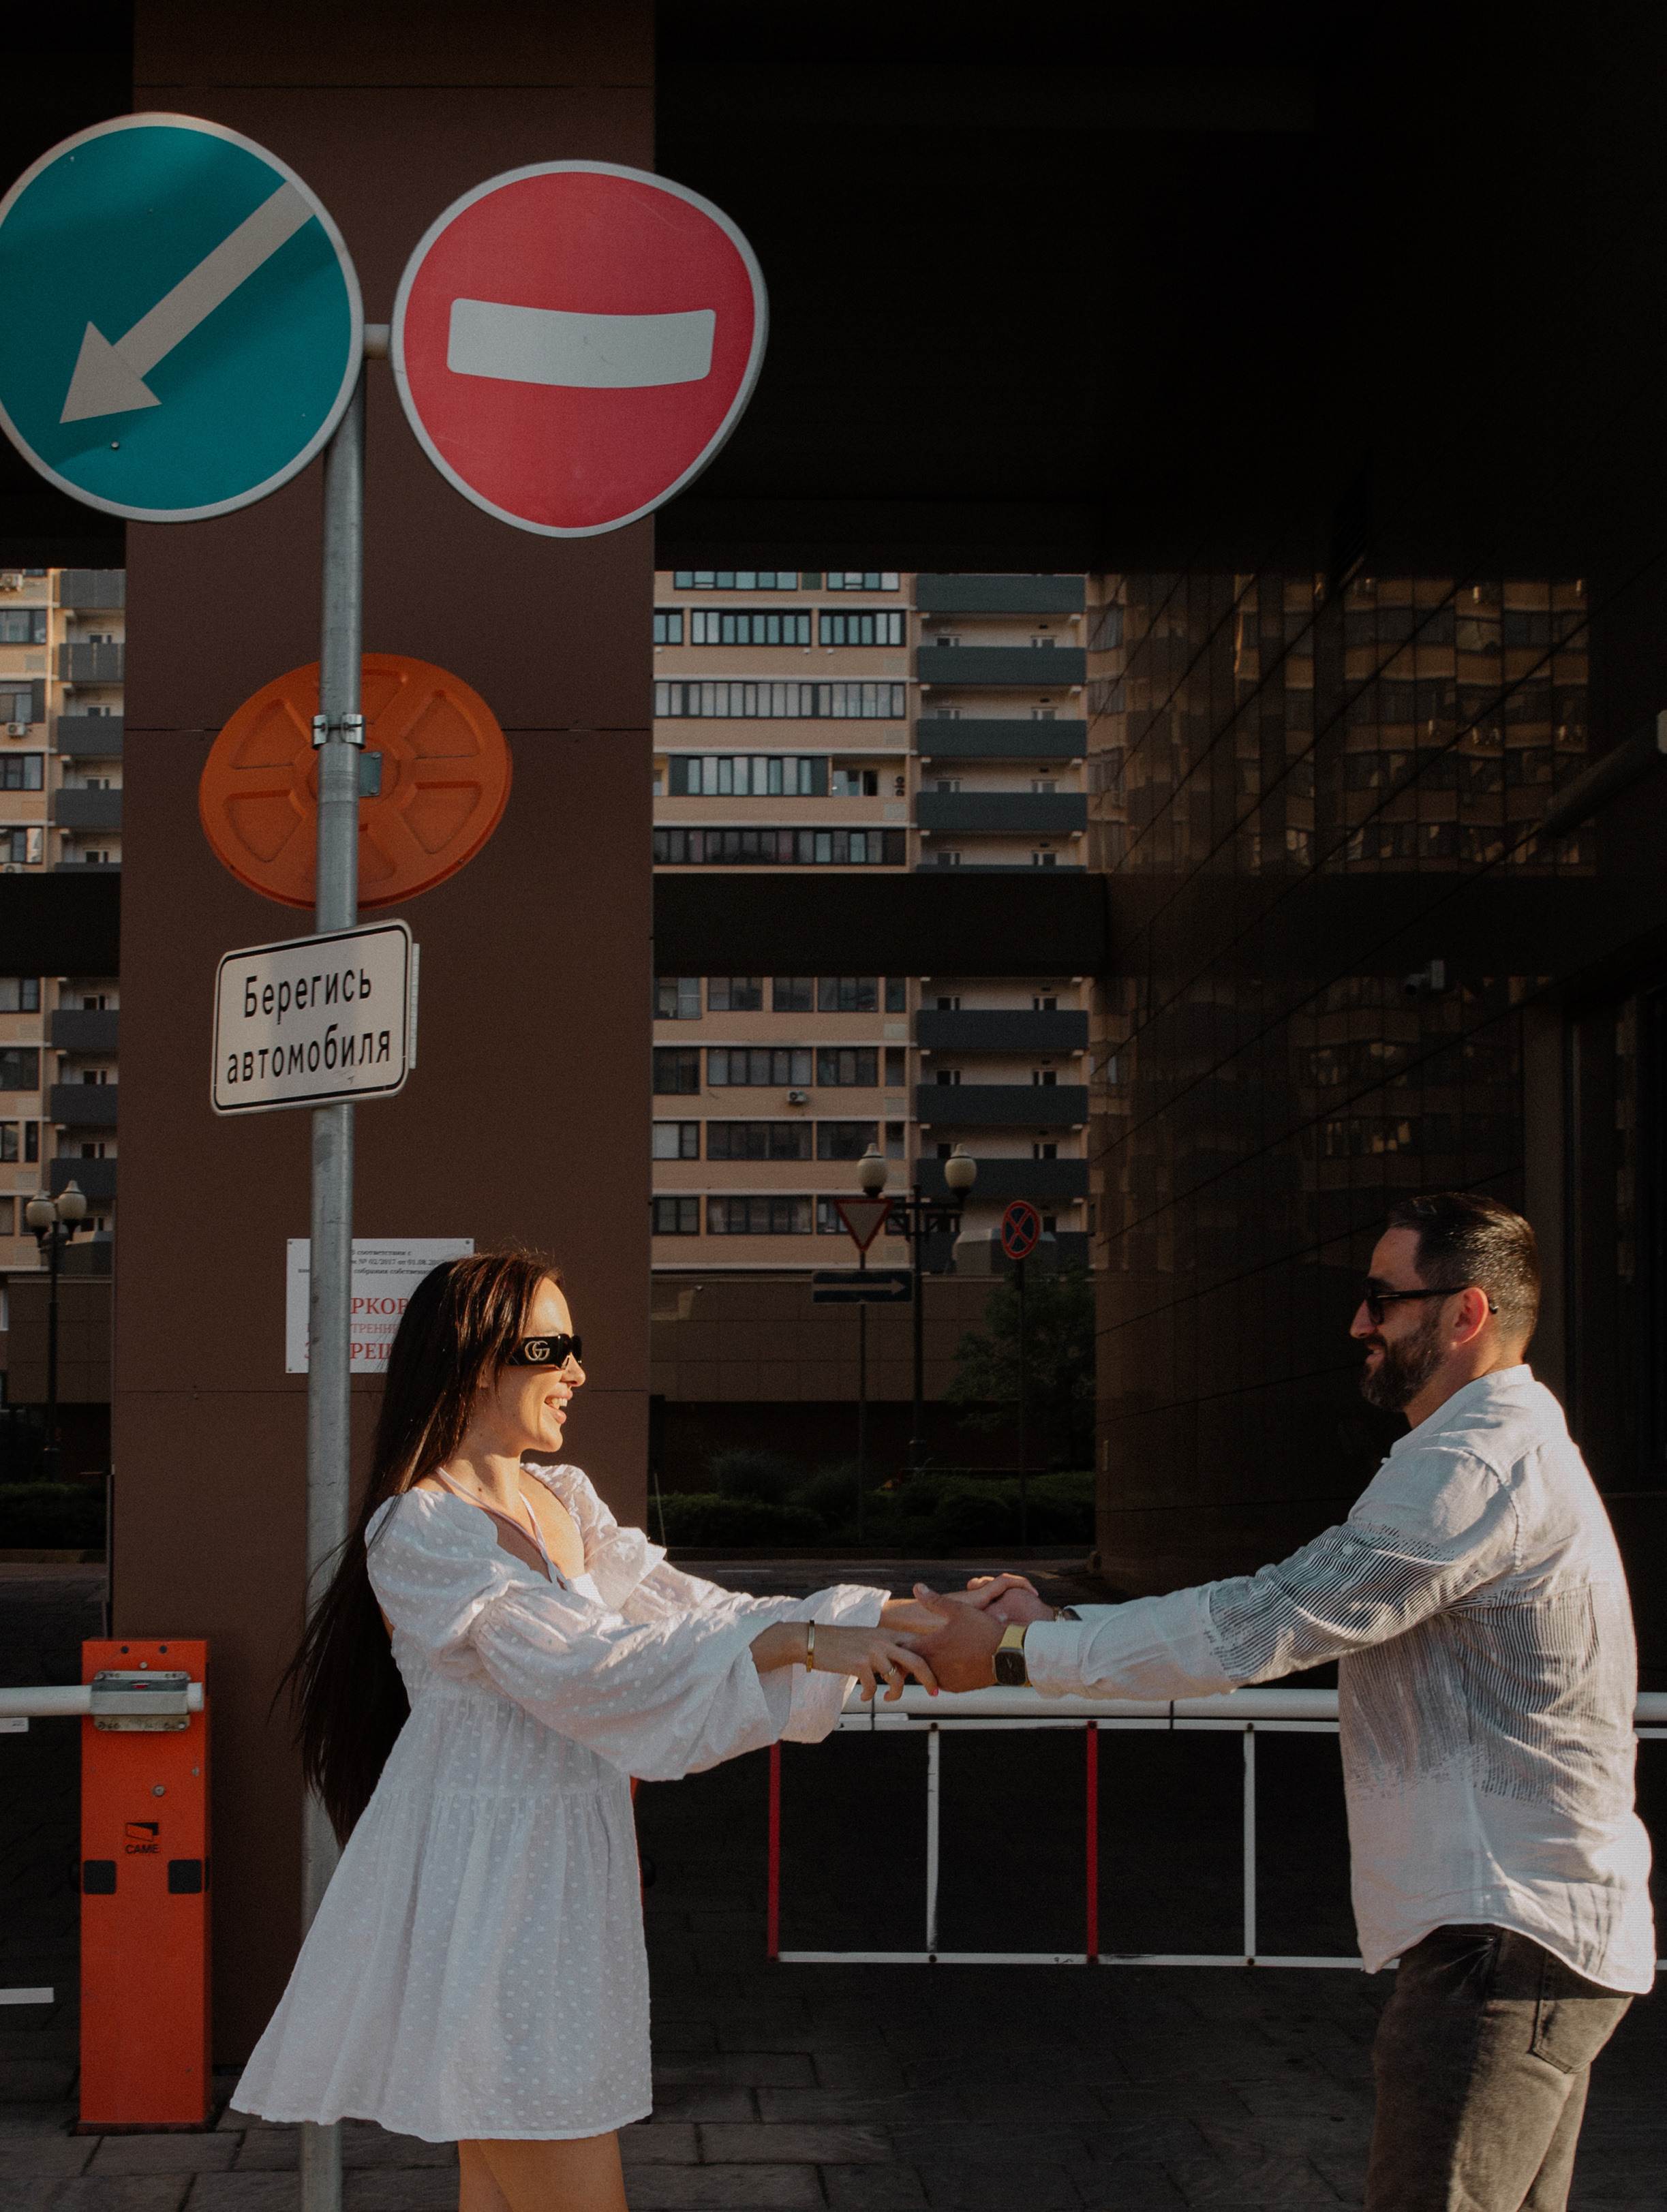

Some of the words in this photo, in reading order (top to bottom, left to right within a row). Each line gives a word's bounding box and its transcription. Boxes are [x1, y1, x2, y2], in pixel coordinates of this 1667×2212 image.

[244, 968, 372, 1024] Берегись
[227, 1024, 391, 1084] автомобиля
[125, 1844, 159, 1854] CAME
